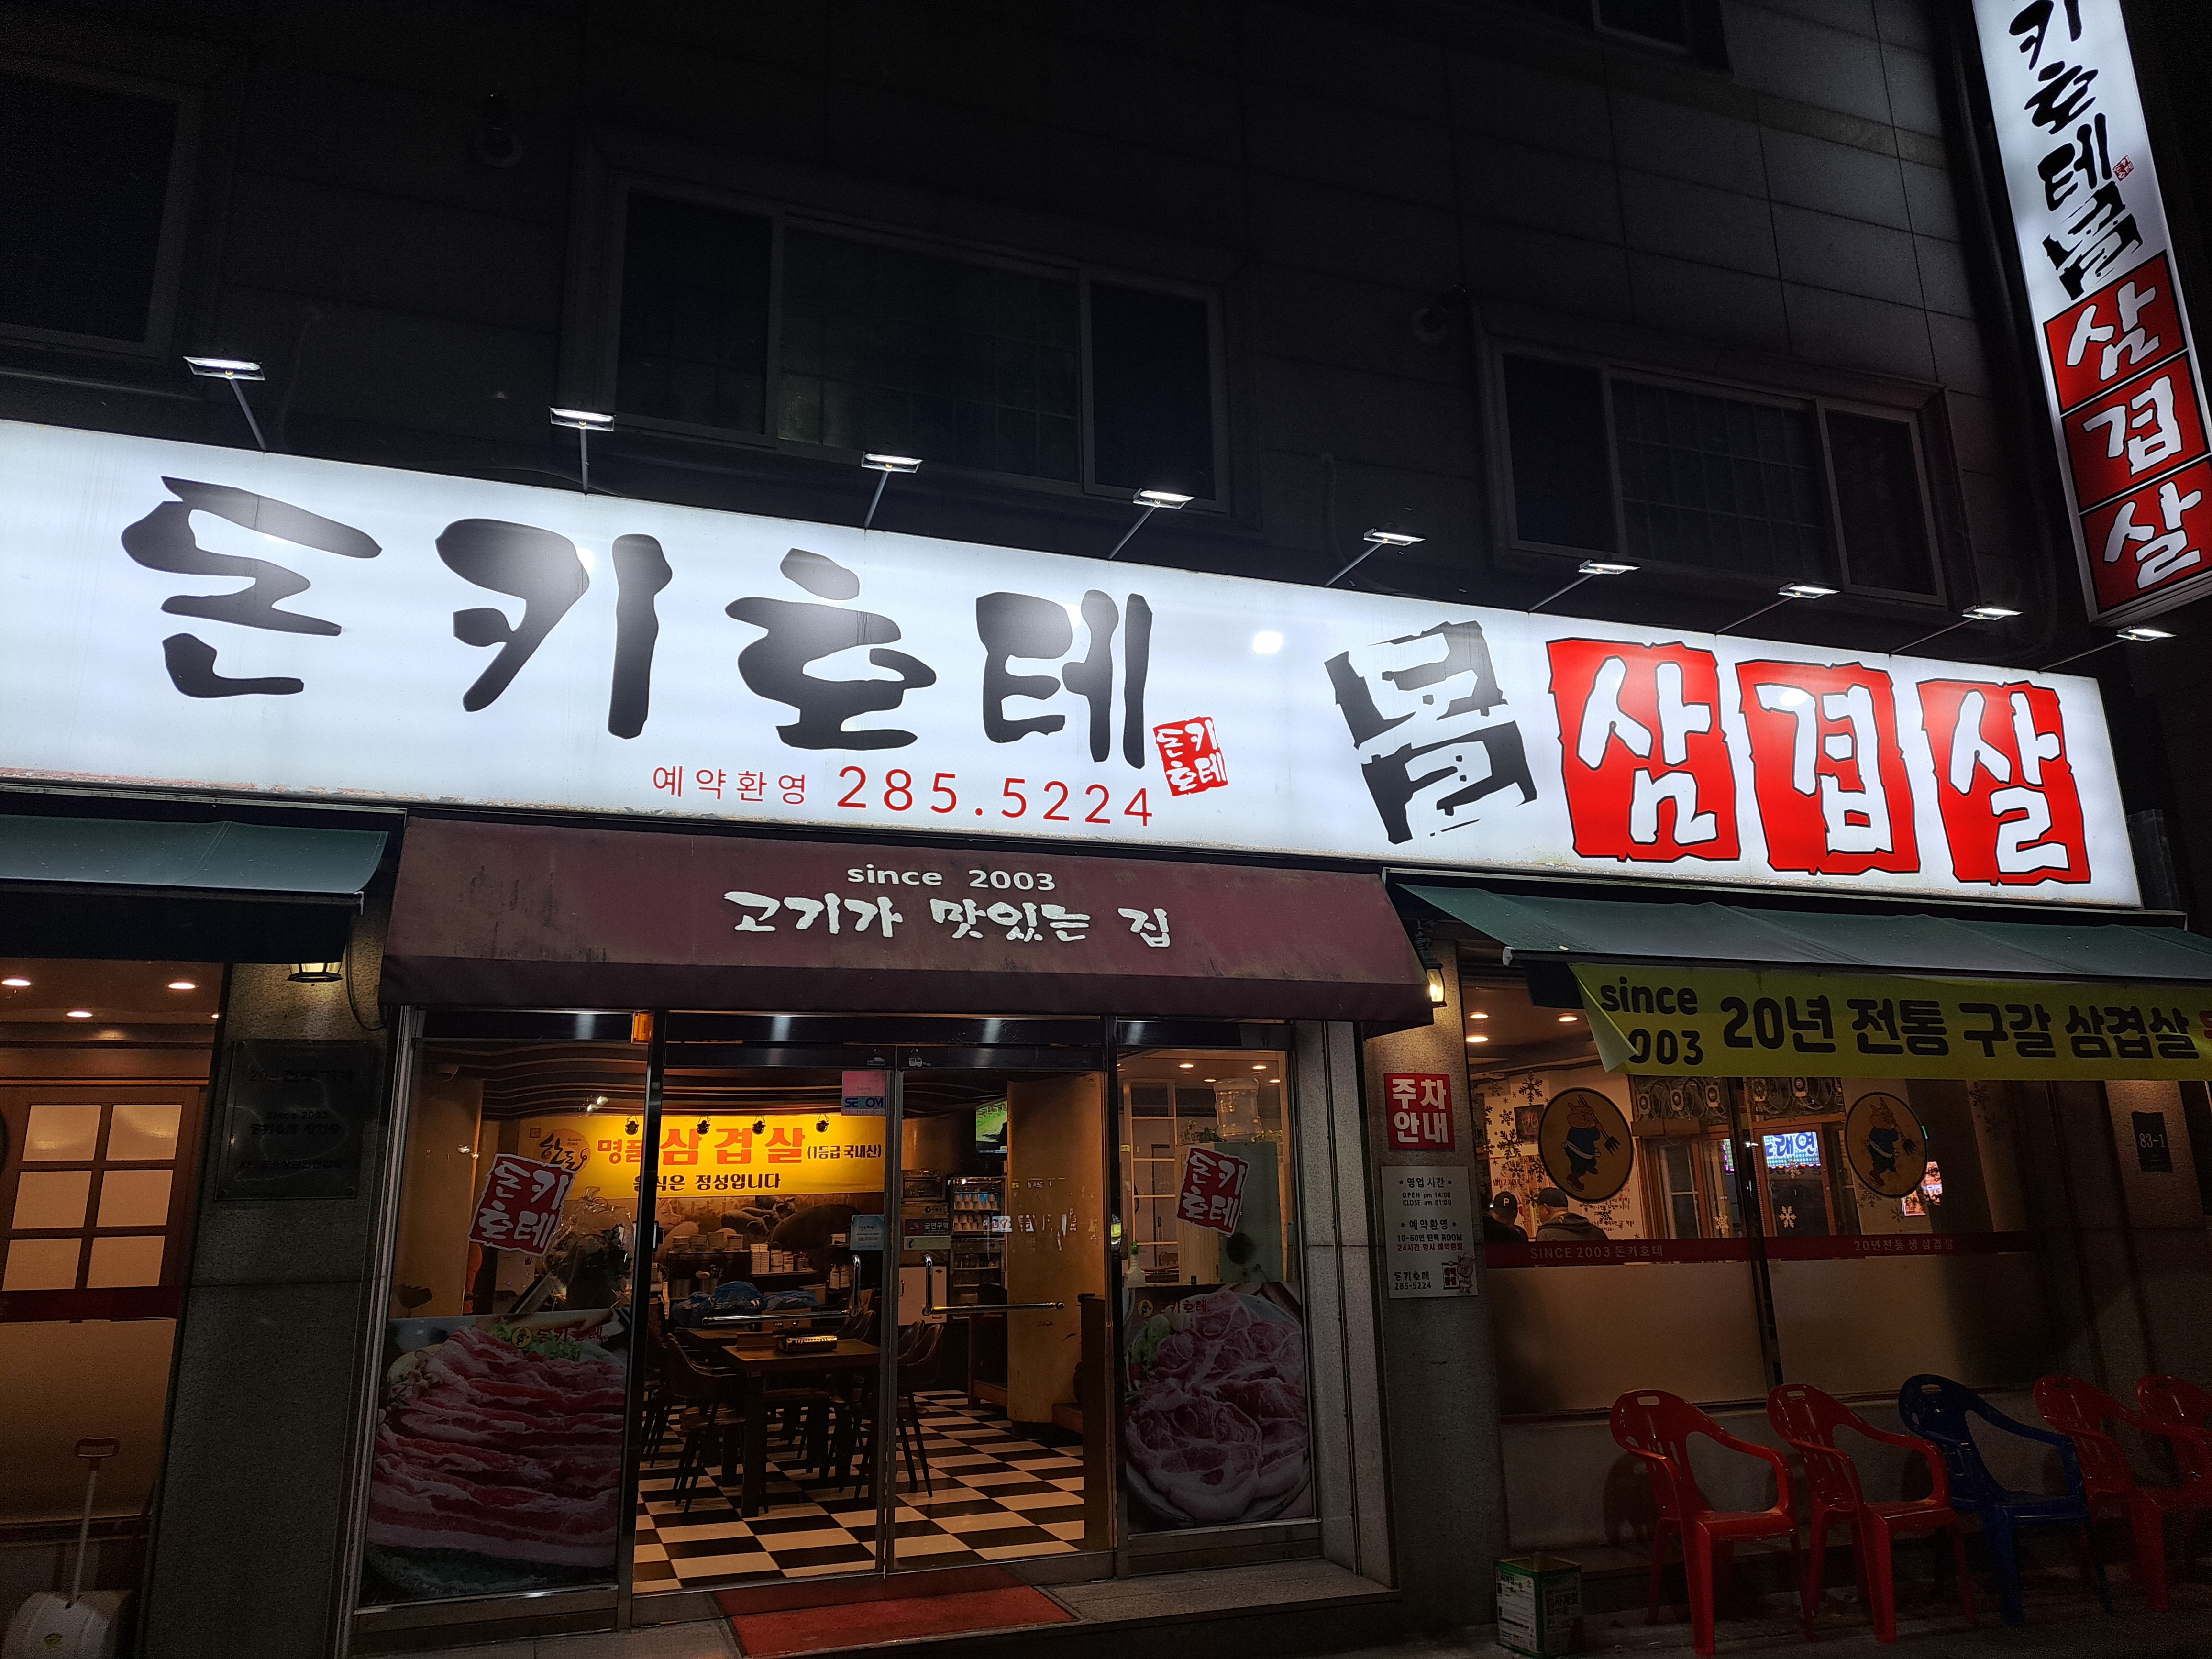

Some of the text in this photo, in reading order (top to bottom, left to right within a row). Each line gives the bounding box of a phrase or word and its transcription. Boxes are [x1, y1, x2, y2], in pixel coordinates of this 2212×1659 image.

[121, 476, 1153, 769] 돈키호테
[652, 765, 1153, 827] 예약환영 285.5224
[847, 864, 1056, 892] since 2003
[724, 891, 1171, 948] 고기가 맛있는 집
[1601, 977, 1697, 1014] since
[1721, 995, 1836, 1053] 20년
[1847, 998, 1949, 1056] 전통
[1958, 1003, 2056, 1057] 구갈
[2066, 1005, 2200, 1059] 삼겹살
[1628, 1029, 1703, 1065] 003
[1392, 1079, 1447, 1109] 주차
[1394, 1112, 1449, 1143] 안내
[2139, 1133, 2166, 1148] 83-1
[807, 1145, 841, 1159] (1등급
[843, 1144, 882, 1159] 국내산)
[696, 1173, 781, 1191] 정성입니다
[1407, 1177, 1445, 1188] 영업 시간
[1409, 1219, 1448, 1230] 예약환영
[1531, 1245, 1663, 1259] SINCE 2003 돈키호테
[1394, 1271, 1429, 1281] 돈키호테
[1394, 1282, 1431, 1290] 285-5224
